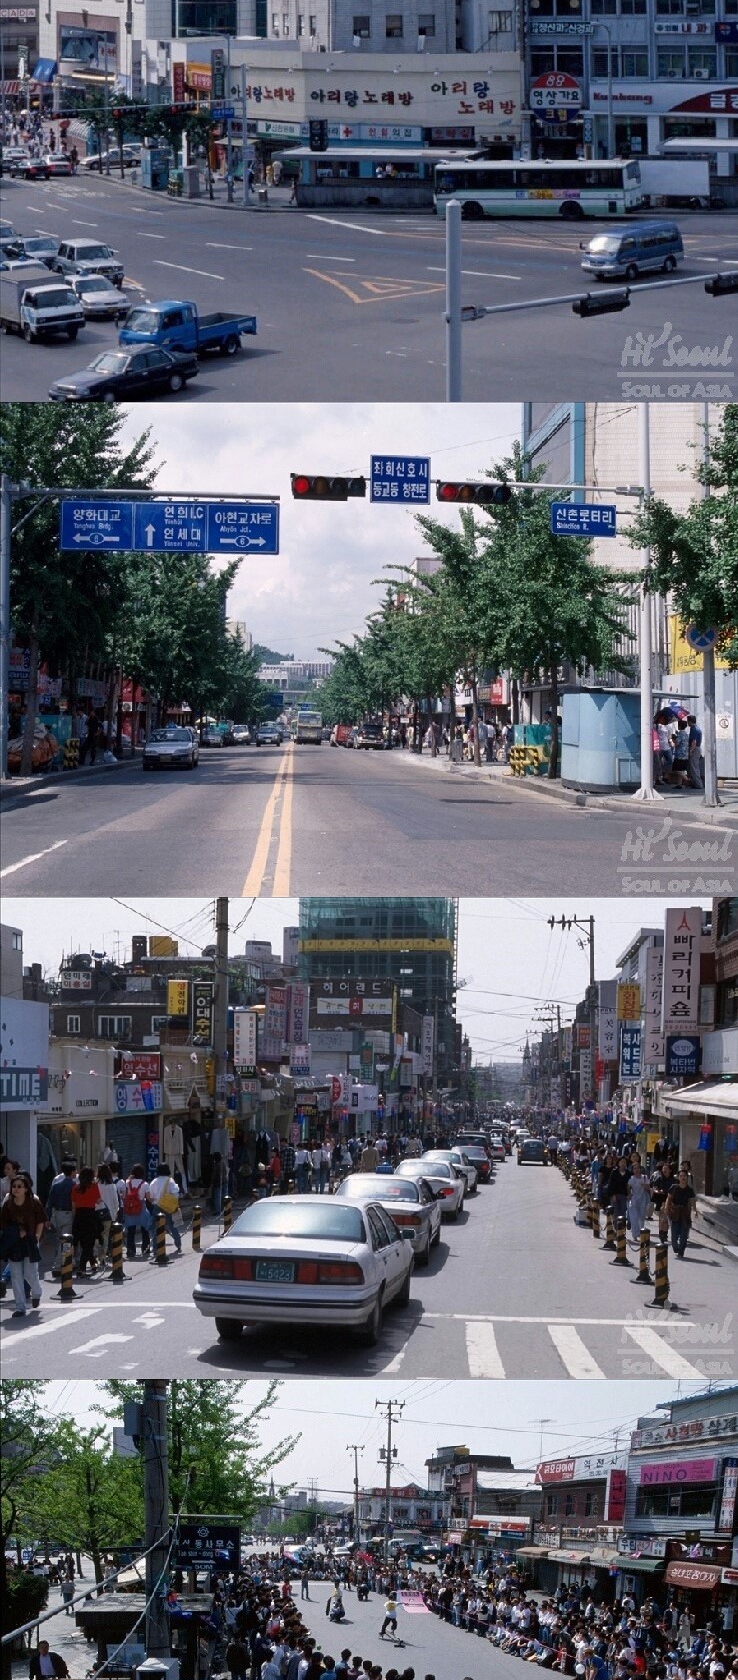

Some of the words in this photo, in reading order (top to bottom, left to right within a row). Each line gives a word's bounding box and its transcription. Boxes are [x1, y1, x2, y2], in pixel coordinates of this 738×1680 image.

[263, 86, 296, 101] 노래방
[310, 88, 359, 108] 아리랑
[362, 89, 415, 107] 노래방
[431, 81, 490, 99] 아리랑
[457, 99, 516, 116] 노래방
[373, 459, 428, 478] 좌회신호시
[372, 482, 399, 498] 동교동
[402, 482, 428, 499] 창전로
[72, 508, 121, 521] 양화대교
[164, 506, 189, 519] 연희
[214, 511, 272, 525] 아현교차로
[555, 507, 613, 525] 신촌로터리
[163, 527, 201, 540] 연세대
[669, 934, 697, 1017] 빠리커피숍
[323, 981, 383, 995] 헤어랜드
[0, 1073, 41, 1097] TIME
[643, 1468, 688, 1483] NINO
